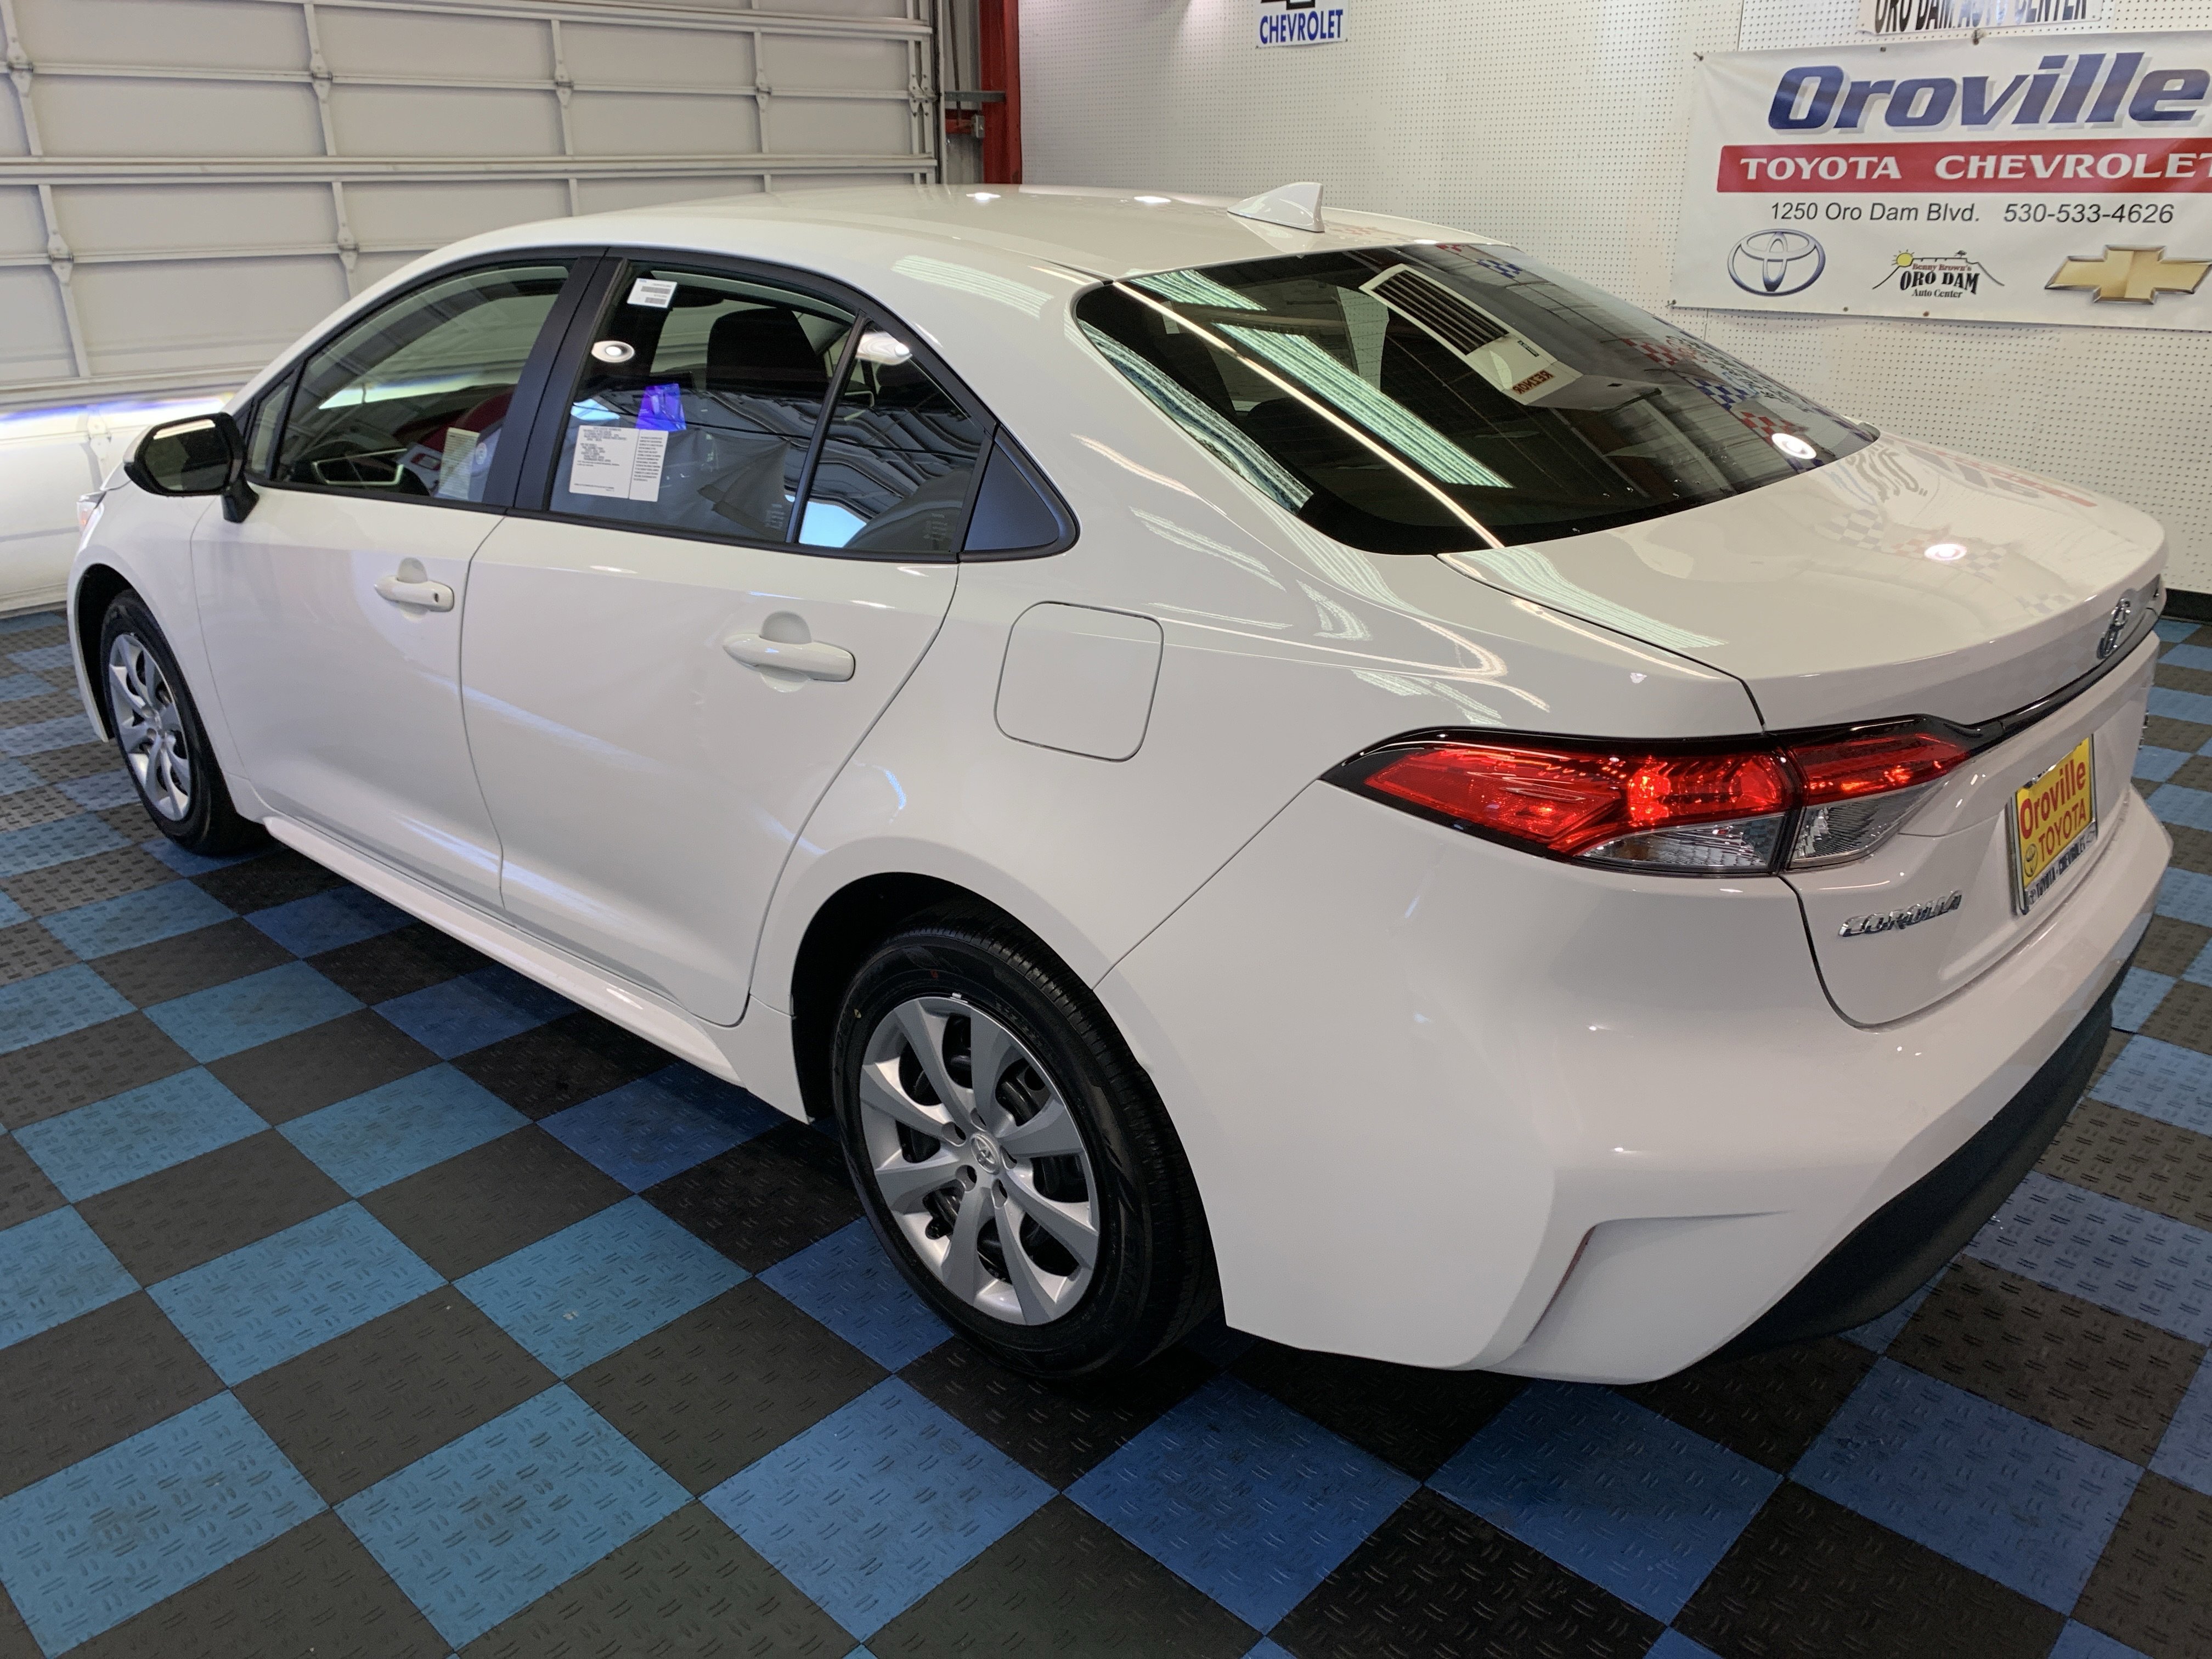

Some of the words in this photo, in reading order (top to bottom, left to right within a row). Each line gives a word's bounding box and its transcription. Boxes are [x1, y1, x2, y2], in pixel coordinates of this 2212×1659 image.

[1260, 9, 1344, 44] CHEVROLET
[1768, 52, 2211, 130] Oroville
[1740, 156, 1901, 180] TOYOTA
[1771, 202, 1818, 220] 1250
[1825, 202, 1862, 221] Oro
[1870, 202, 1918, 221] Dam
[1926, 202, 1979, 221] Blvd.
[2004, 204, 2175, 223] 530-533-4626
[1912, 263, 1938, 272] Benny
[1939, 263, 1972, 272] Brown's
[1900, 270, 1937, 290] ORO
[1942, 272, 1980, 295] DAM
[1911, 289, 1932, 297] Auto
[1934, 289, 1963, 298] Center
[2020, 759, 2086, 839] Oroville
[2039, 798, 2086, 862] TOYOTA
